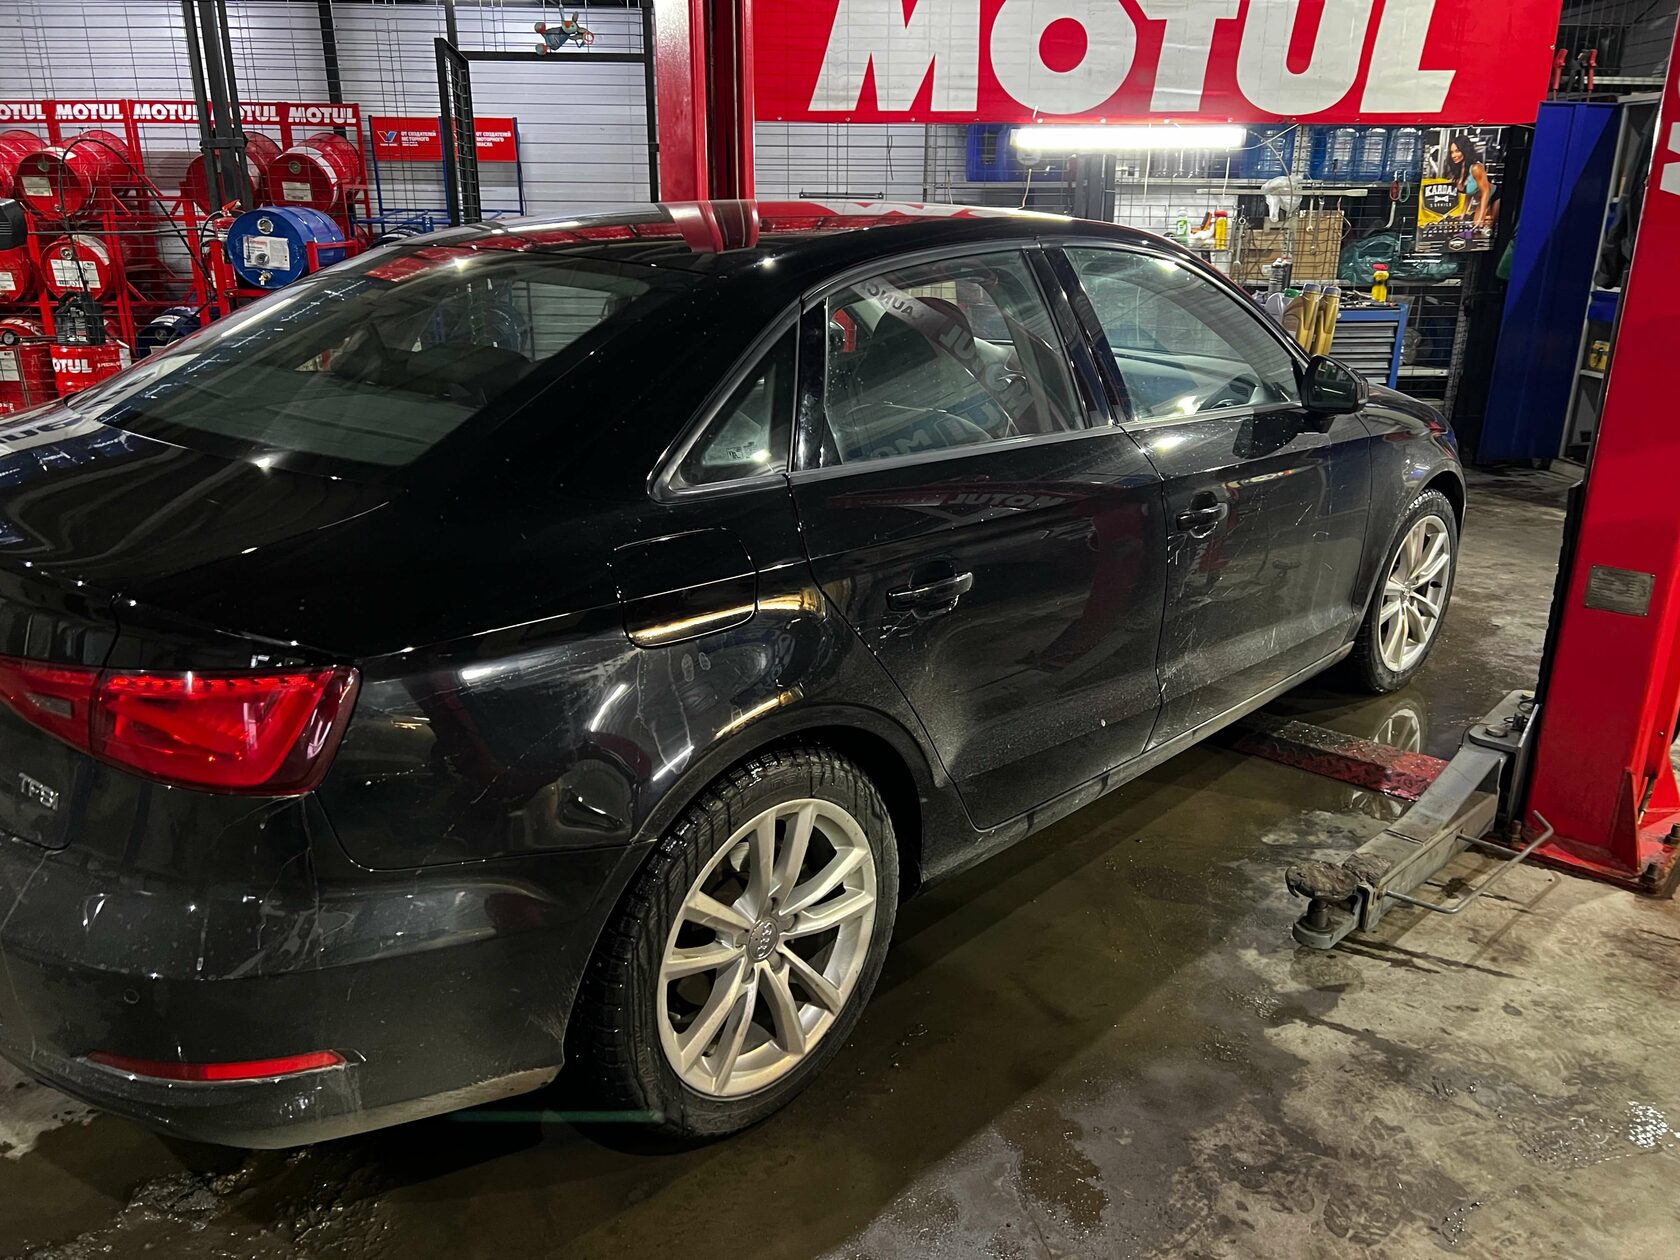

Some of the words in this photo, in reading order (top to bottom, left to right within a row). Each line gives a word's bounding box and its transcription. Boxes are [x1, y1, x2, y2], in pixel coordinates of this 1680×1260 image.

[807, 0, 1456, 115] MOTUL
[0, 104, 47, 120] OTUL
[55, 104, 124, 120] MOTUL
[288, 106, 357, 124] MOTUL
